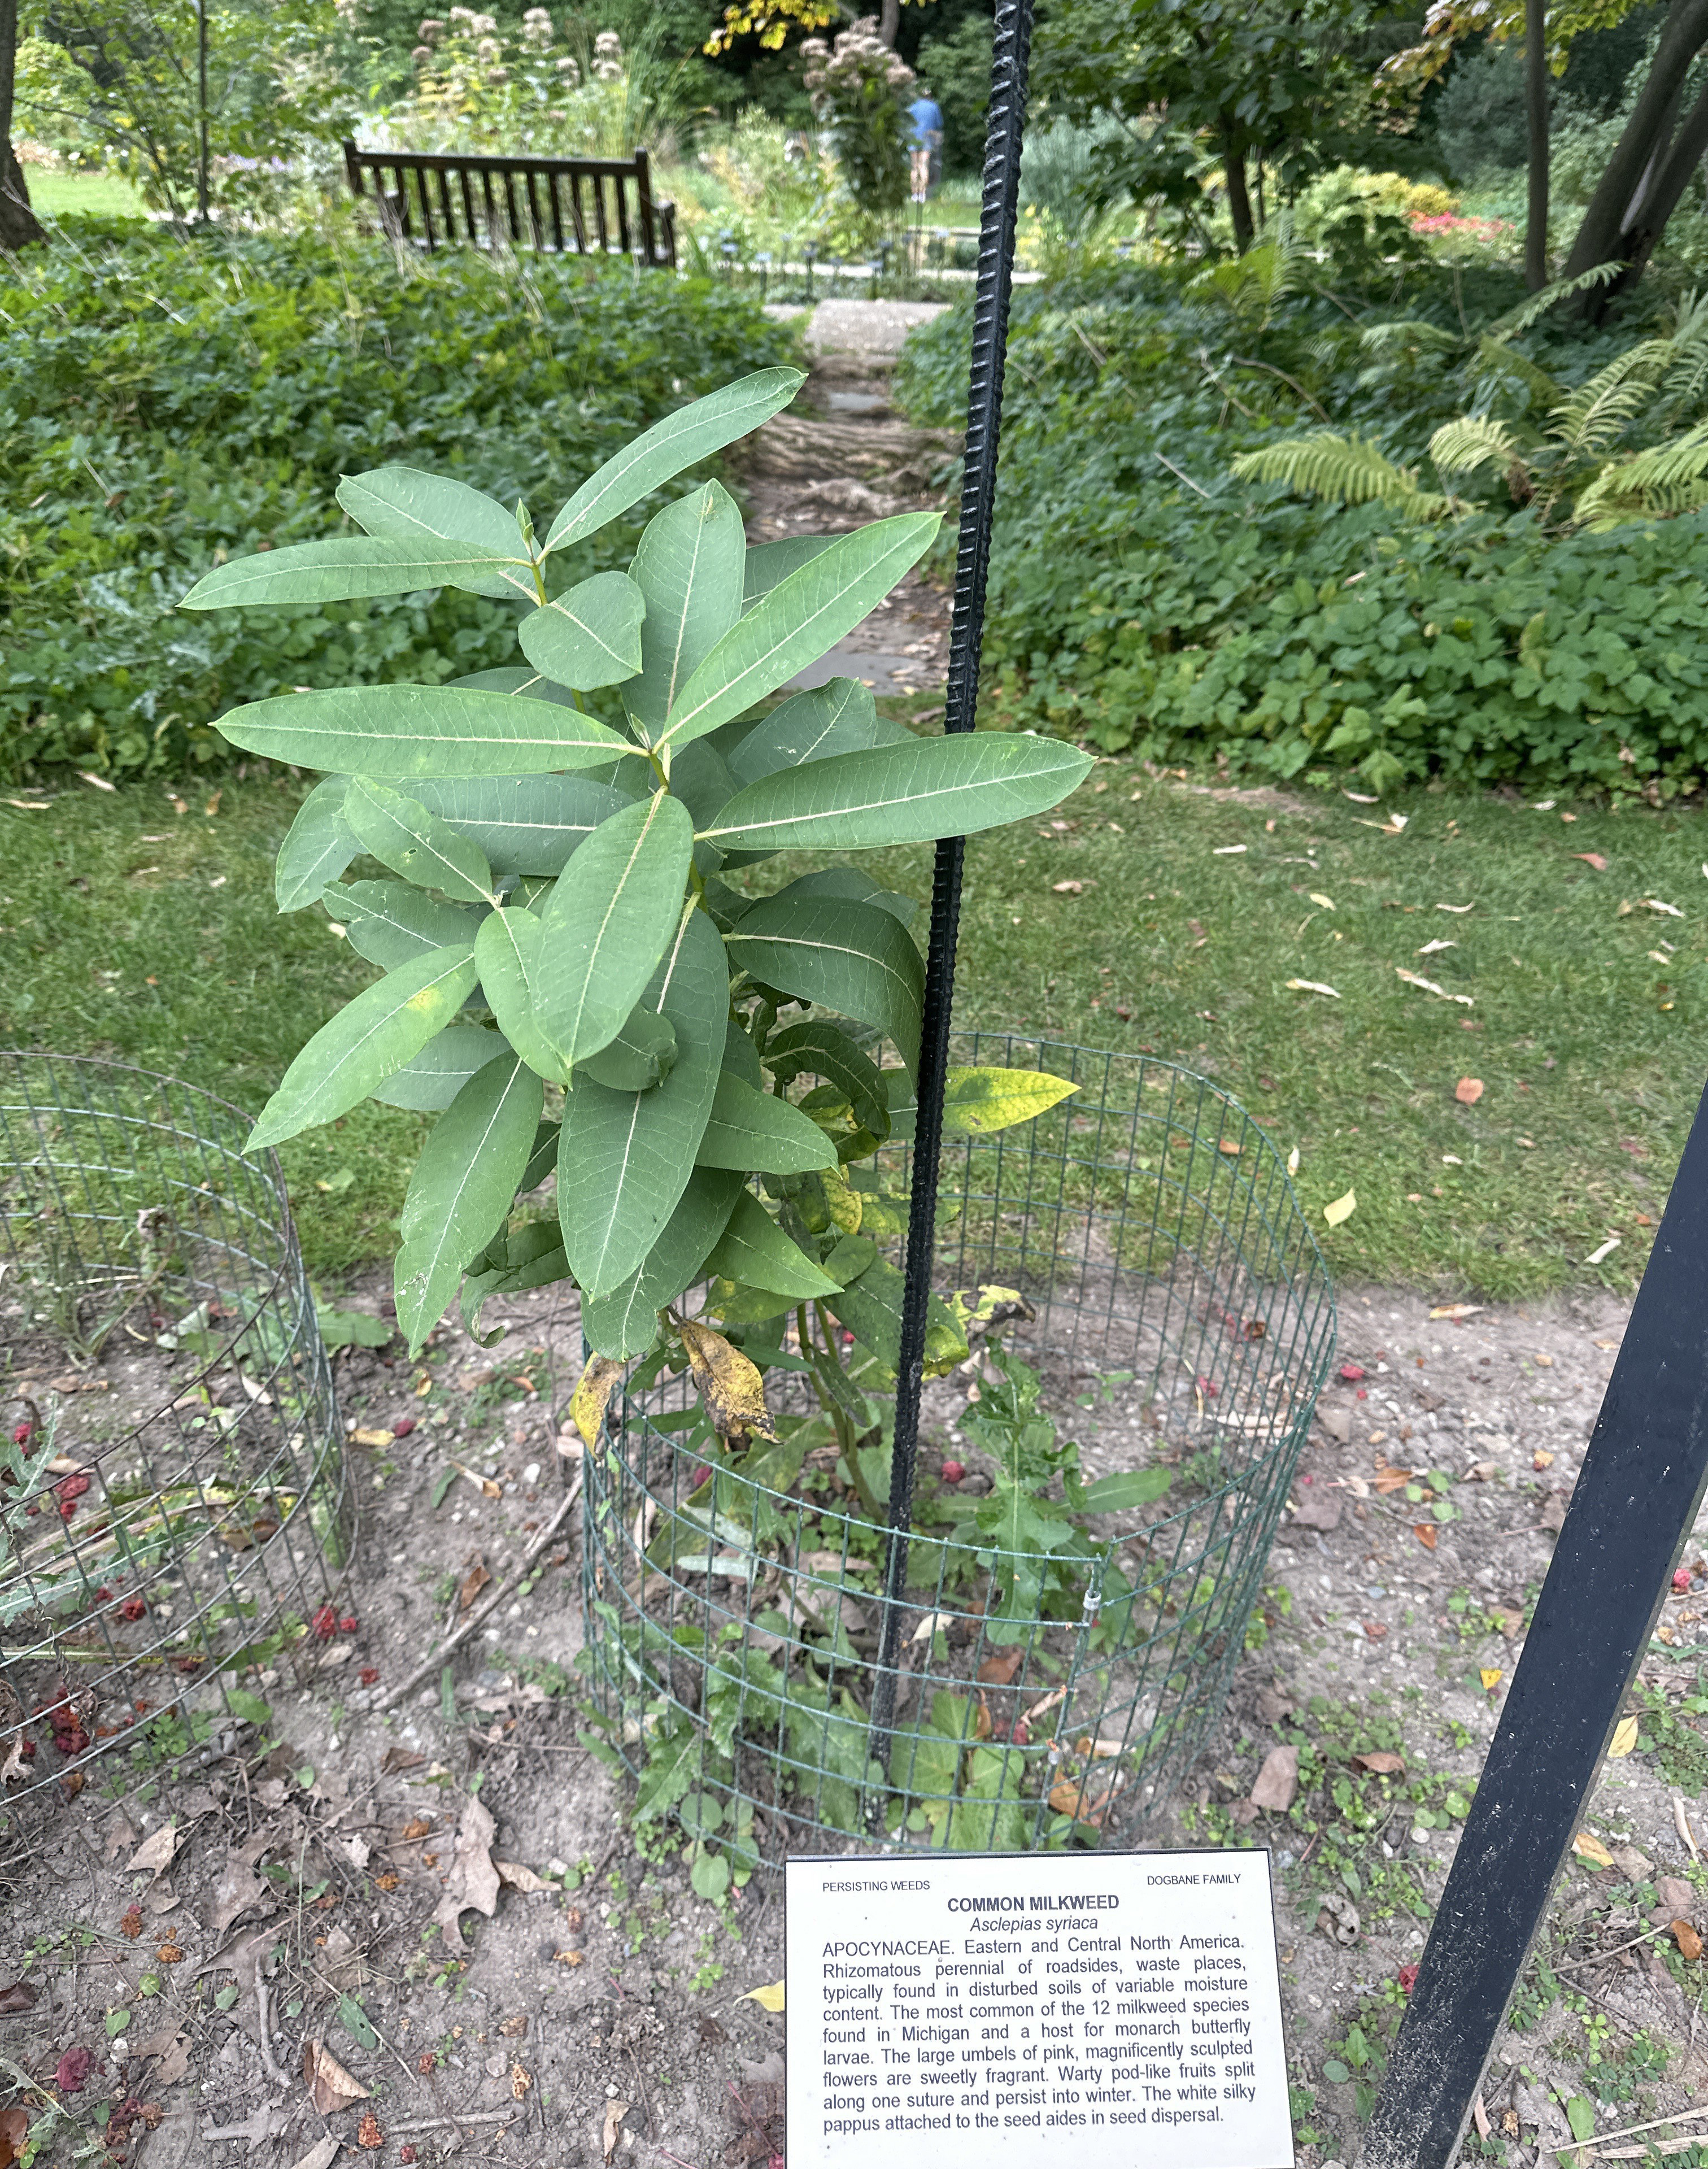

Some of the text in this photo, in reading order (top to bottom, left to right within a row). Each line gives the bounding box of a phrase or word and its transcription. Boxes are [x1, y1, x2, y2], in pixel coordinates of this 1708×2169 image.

[822, 1880, 930, 1892] PERSISTING WEEDS
[1147, 1874, 1241, 1885] DOGBANE FAMILY
[947, 1894, 1119, 1912] COMMON MILKWEED
[969, 1915, 1098, 1935] Asclepias syriaca
[822, 1933, 1244, 1957] APOCYNACEAE. Eastern and Central North America.
[823, 1955, 1246, 1980] Rhizomatous perennial of roadsides, waste places,
[822, 1976, 1248, 2004] typically found in disturbed soils of variable moisture
[823, 1996, 1249, 2021] content. The most common of the 12 milkweed species
[822, 2018, 1251, 2044] found in Michigan and a host for monarch butterfly
[823, 2039, 1253, 2066] larvae. The large umbels of pink, magnificently sculpted
[822, 2061, 1256, 2087] flowers are sweetly fragrant. Warty pod-like fruits split
[823, 2083, 1256, 2112] along one suture and persist into winter. The white silky
[823, 2105, 1223, 2136] pappus attached to the seed aides in seed dispersal.
